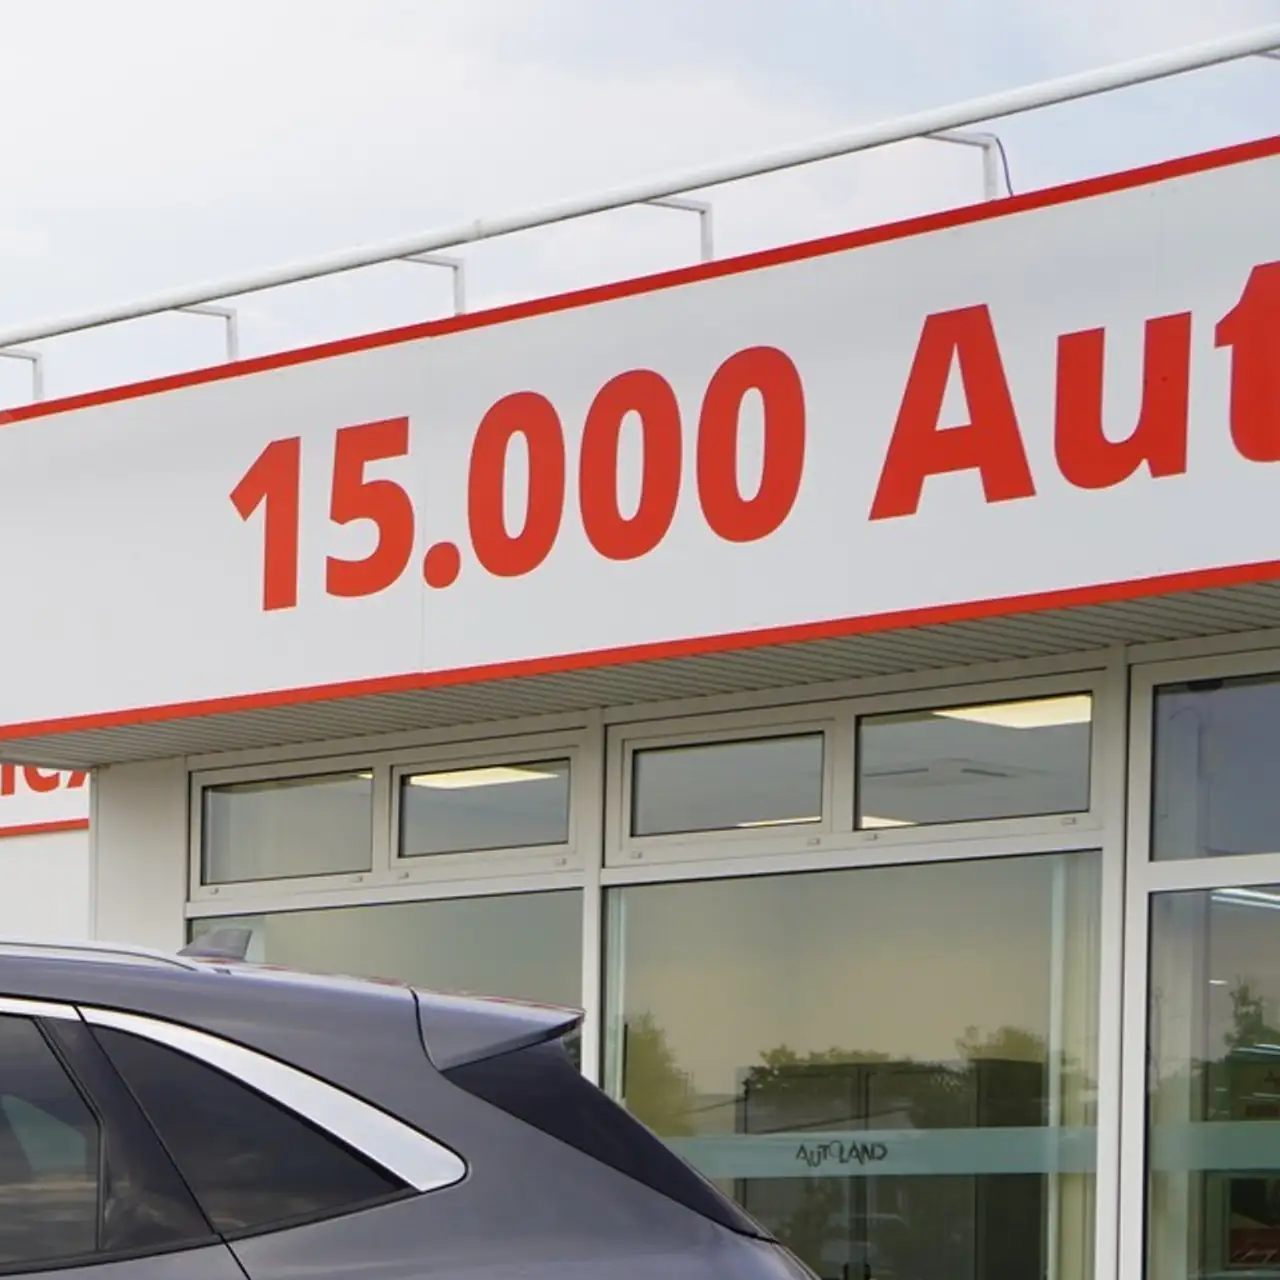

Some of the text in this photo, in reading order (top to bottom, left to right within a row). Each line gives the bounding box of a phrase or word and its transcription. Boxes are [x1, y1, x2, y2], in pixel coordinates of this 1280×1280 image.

[228, 261, 1280, 612] 15.000 Aut
[795, 1139, 889, 1168] AUTOLAND
